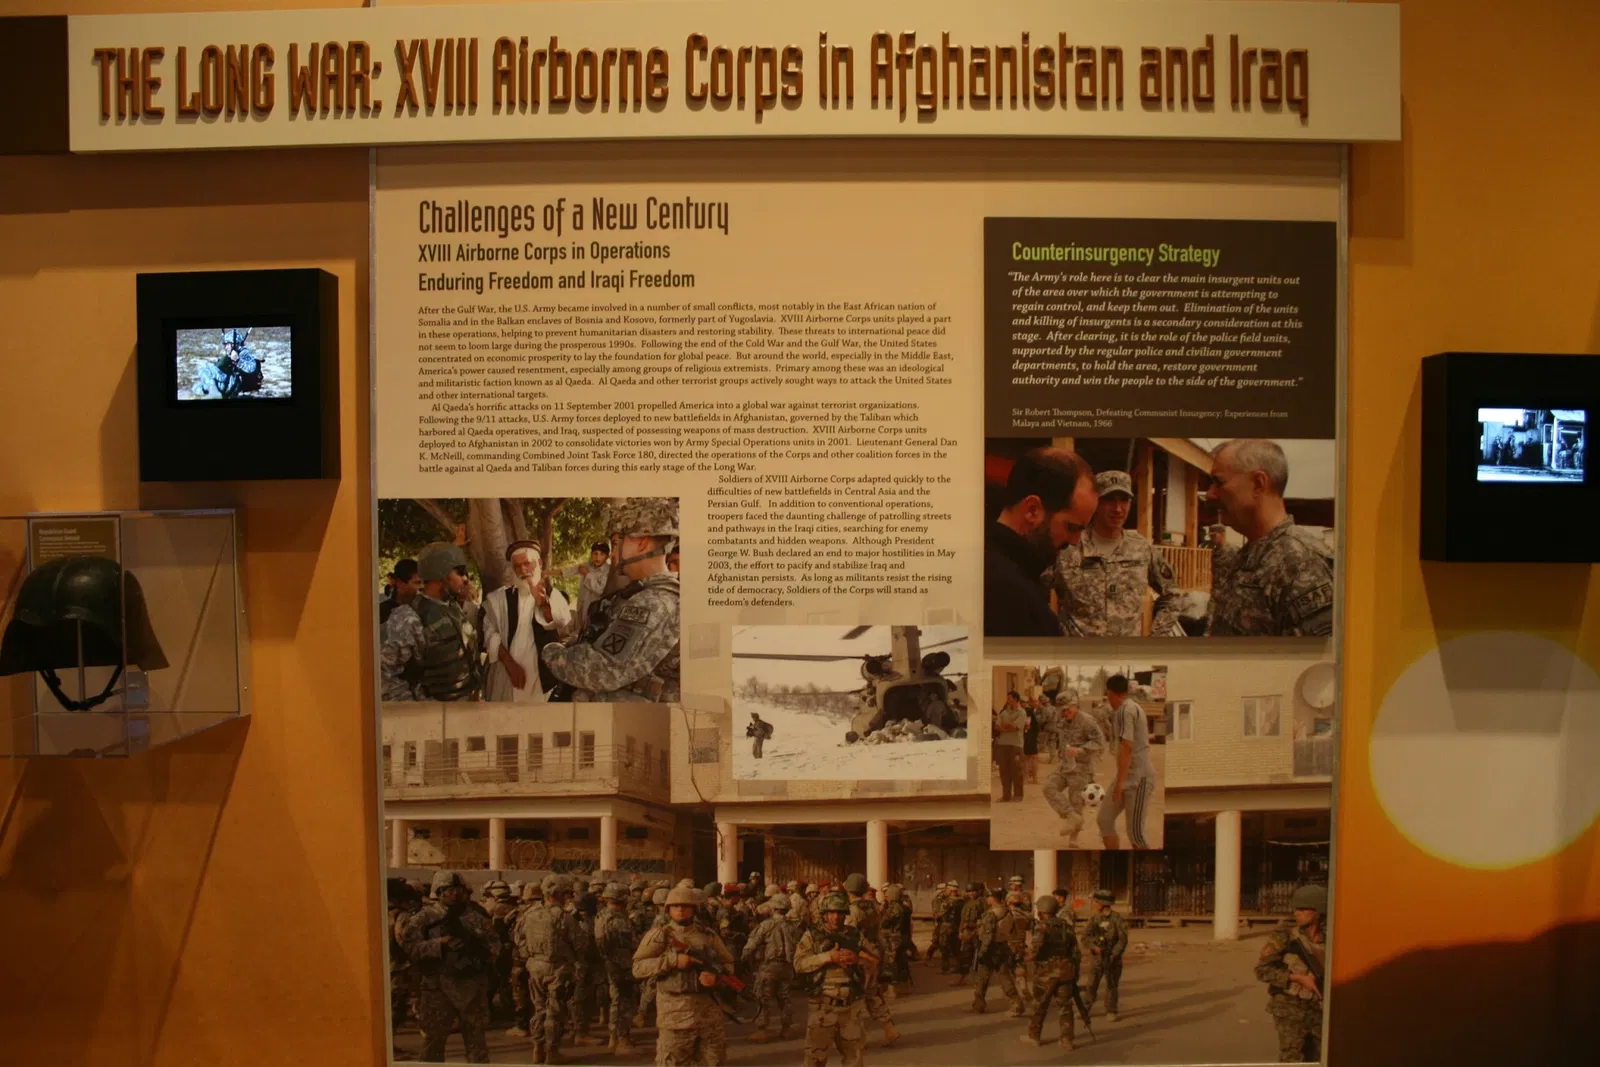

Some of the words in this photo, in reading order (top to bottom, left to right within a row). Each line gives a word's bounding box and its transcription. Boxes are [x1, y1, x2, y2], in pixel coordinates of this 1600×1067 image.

[94, 46, 165, 119] THE
[178, 43, 275, 117] LONG
[288, 40, 382, 116] WAR:
[394, 37, 479, 114] XVIII
[495, 36, 669, 112] Airborne
[685, 31, 804, 121] Corps
[819, 30, 855, 105] in
[870, 29, 1124, 122] Afghanistan
[1139, 33, 1215, 109] and
[1229, 33, 1310, 124] Iraq
[418, 200, 536, 238] Challenges
[543, 198, 566, 237] of
[571, 203, 584, 231] a
[592, 197, 639, 230] New
[646, 196, 729, 235] Century
[418, 244, 451, 263] XVIII
[455, 243, 519, 262] Airborne
[524, 243, 567, 264] Corps
[571, 242, 585, 260] in
[590, 241, 671, 264] Operations
[1012, 241, 1155, 266] Counterinsurgency
[1158, 243, 1221, 268] Strategy
[418, 272, 483, 295] Enduring
[489, 271, 554, 291] Freedom
[558, 271, 585, 290] and
[590, 270, 625, 292] Iraqi
[629, 270, 695, 288] Freedom
[1007, 271, 1030, 282] “The
[1031, 271, 1067, 285] Army’s
[1068, 272, 1088, 282] role
[1089, 272, 1112, 283] here
[1113, 272, 1122, 283] is
[1123, 272, 1134, 283] to
[1136, 272, 1160, 283] clear
[1162, 273, 1179, 283] the
[1180, 273, 1206, 283] main
[1207, 273, 1254, 287] insurgent
[1256, 274, 1282, 284] units
[1283, 274, 1300, 284] out
[1011, 286, 1023, 298] of
[1024, 286, 1041, 297] the
[1042, 289, 1065, 297] area
[1066, 289, 1089, 297] over
[1090, 287, 1119, 297] which
[1121, 287, 1138, 298] the
[1139, 287, 1199, 301] government
[1200, 288, 1209, 298] is
[1210, 288, 1266, 302] attempting
[1268, 288, 1278, 299] to
[418, 305, 439, 314] After
[441, 305, 455, 314] the
[456, 305, 475, 314] Gulf
[477, 305, 498, 315] War,
[498, 304, 512, 314] the
[514, 304, 532, 313] U.S.
[532, 304, 556, 316] Army
[557, 304, 589, 313] became
[591, 304, 627, 313] involved
[628, 304, 638, 313] in
[646, 303, 680, 313] number
[681, 303, 691, 312] of
[692, 303, 716, 312] small
[717, 303, 757, 313] conflicts,
[758, 303, 779, 312] most
[781, 302, 814, 314] notably
[816, 302, 825, 311] in
[826, 302, 841, 311] the
[843, 302, 861, 311] East
[863, 302, 895, 311] African
[897, 302, 925, 311] nation
[927, 302, 936, 311] of
[1011, 374, 1060, 388] authority
[1061, 374, 1081, 385] and
[1083, 374, 1101, 385] win
[1103, 375, 1120, 385] the
[1121, 375, 1153, 388] people
[1155, 375, 1166, 385] to
[1168, 375, 1184, 386] the
[1185, 375, 1205, 386] side
[1207, 375, 1218, 388] of
[1219, 375, 1235, 386] the
[1236, 375, 1303, 389] government.”
[418, 414, 459, 426] Following
[460, 414, 474, 423] the
[475, 414, 495, 423] 9/11
[498, 414, 532, 425] attacks,
[532, 414, 550, 423] U.S.
[550, 414, 574, 425] Army
[575, 414, 601, 423] forces
[602, 414, 641, 425] deployed
[642, 414, 652, 423] to
[673, 413, 721, 423] battlefields
[722, 413, 731, 422] in
[733, 413, 789, 425] Afghanistan,
[789, 413, 829, 424] governed
[831, 413, 841, 424] by
[843, 413, 858, 422] the
[859, 413, 891, 422] Taliban
[893, 413, 919, 422] which
[1012, 418, 1039, 430] Malaya
[1040, 418, 1055, 428] and
[1093, 418, 1112, 428] 1966
[718, 474, 752, 483] Soldiers
[754, 474, 763, 483] of
[764, 474, 788, 483] XVIII
[789, 474, 828, 483] Airborne
[829, 474, 855, 486] Corps
[857, 474, 891, 486] adapted
[893, 474, 924, 486] quickly
[925, 474, 935, 483] to
[936, 474, 951, 483] the
[707, 511, 743, 523] troopers
[745, 511, 768, 520] faced
[769, 511, 784, 520] the
[785, 511, 825, 523] daunting
[826, 511, 866, 523] challenge
[868, 511, 877, 520] of
[879, 511, 921, 523] patrolling
[922, 511, 951, 520] streets
[707, 548, 738, 560] George
[739, 548, 751, 557] W.
[752, 548, 774, 557] Bush
[775, 548, 811, 557] declared
[825, 548, 842, 557] end
[844, 548, 853, 557] to
[855, 550, 880, 560] major
[881, 548, 924, 557] hostilities
[926, 548, 935, 557] in
[937, 548, 955, 560] May
[707, 573, 759, 584] Afghanistan
[761, 573, 798, 584] persists.
[800, 573, 812, 582] As
[813, 573, 833, 584] long
[845, 573, 884, 582] militants
[886, 573, 909, 582] resist
[911, 573, 925, 582] the
[927, 573, 952, 584] rising
[707, 597, 749, 607] freedom's
[750, 597, 796, 607] defenders.
